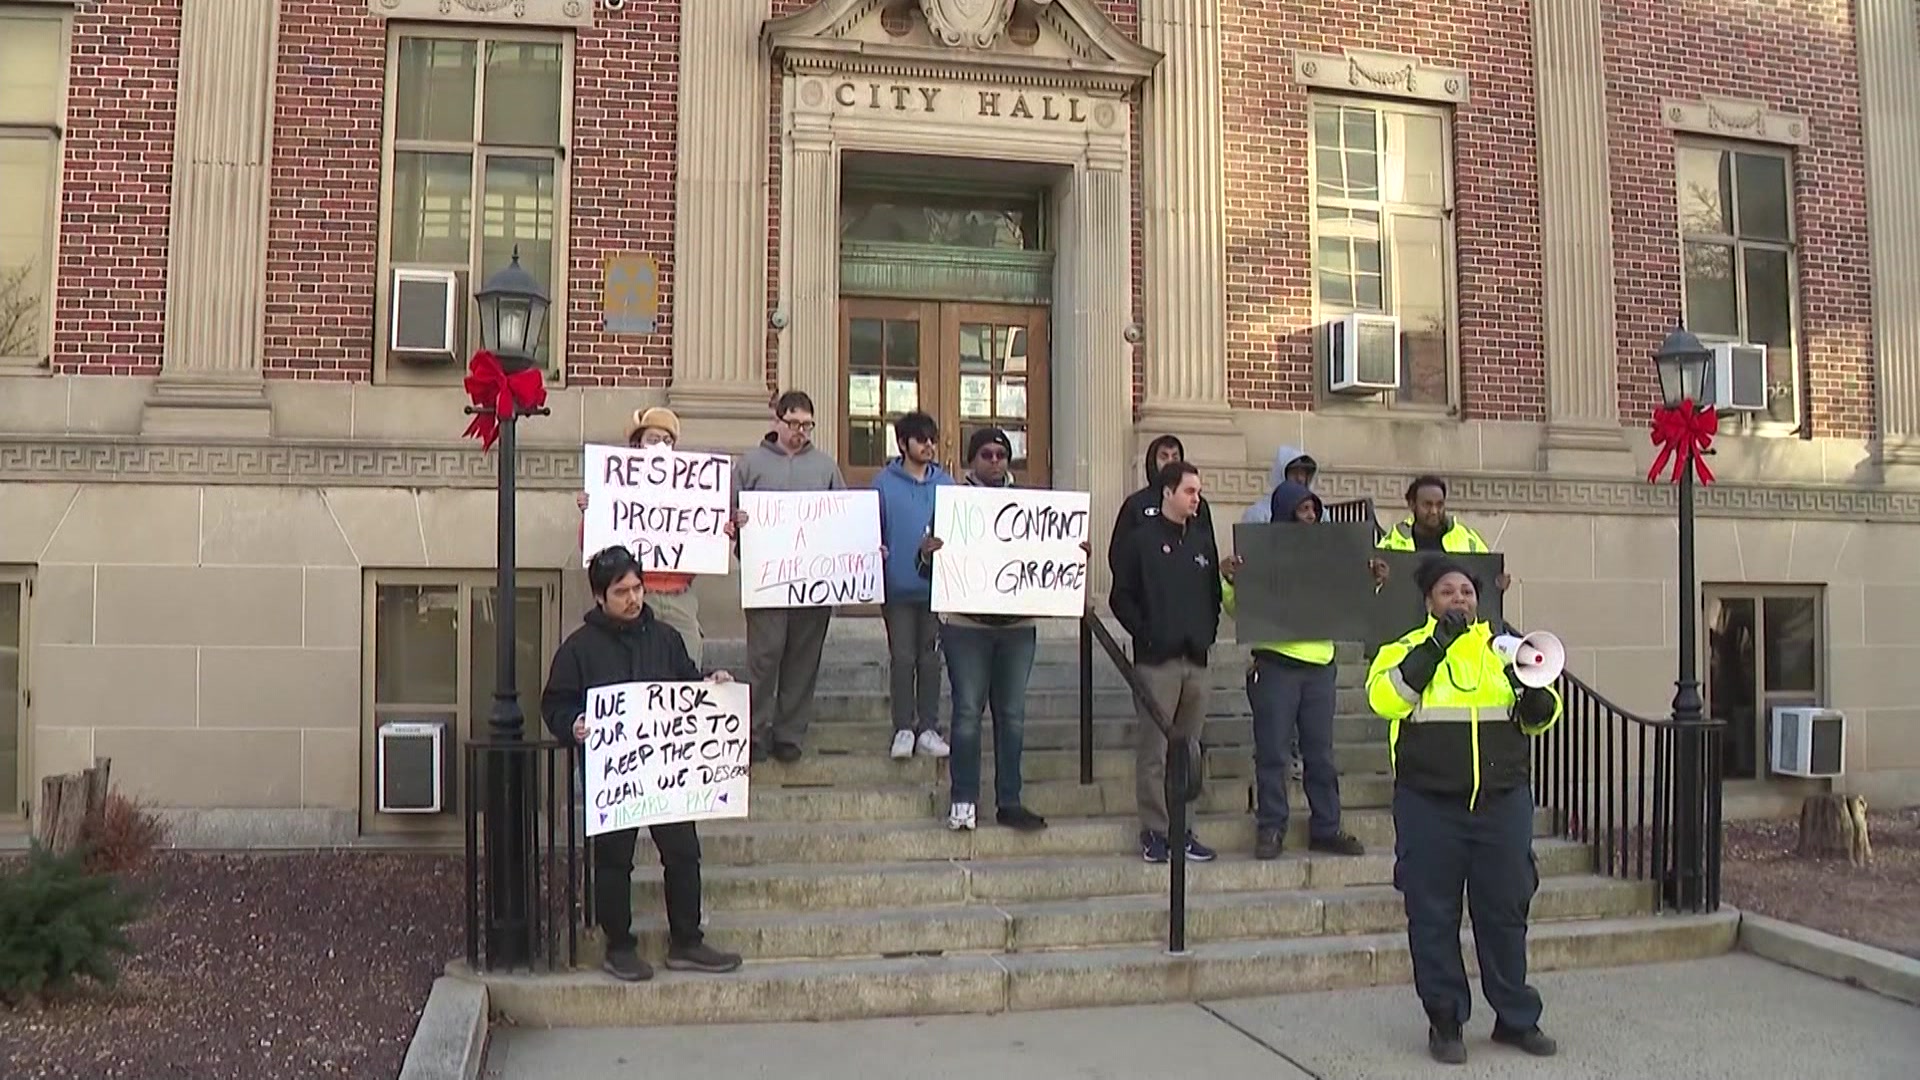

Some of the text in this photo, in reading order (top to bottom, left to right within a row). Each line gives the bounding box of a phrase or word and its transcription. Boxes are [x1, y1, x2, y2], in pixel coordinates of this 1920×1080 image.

[835, 82, 1087, 123] CITY HALL
[605, 455, 729, 492] RESPECT
[613, 500, 726, 536] PROTECT
[757, 494, 853, 528] WE WANT
[950, 500, 1088, 546] NO CONTRACT
[632, 538, 684, 570] PAY
[795, 527, 807, 551] A
[761, 556, 804, 586] FAIR
[938, 553, 1086, 602] NO GARBAGE
[595, 684, 718, 720] WE RISK
[590, 713, 740, 751] OUR LIVES TO
[604, 737, 748, 782] KEEP THE CITY
[595, 778, 645, 810] CLEAN
[657, 767, 689, 791] WE
